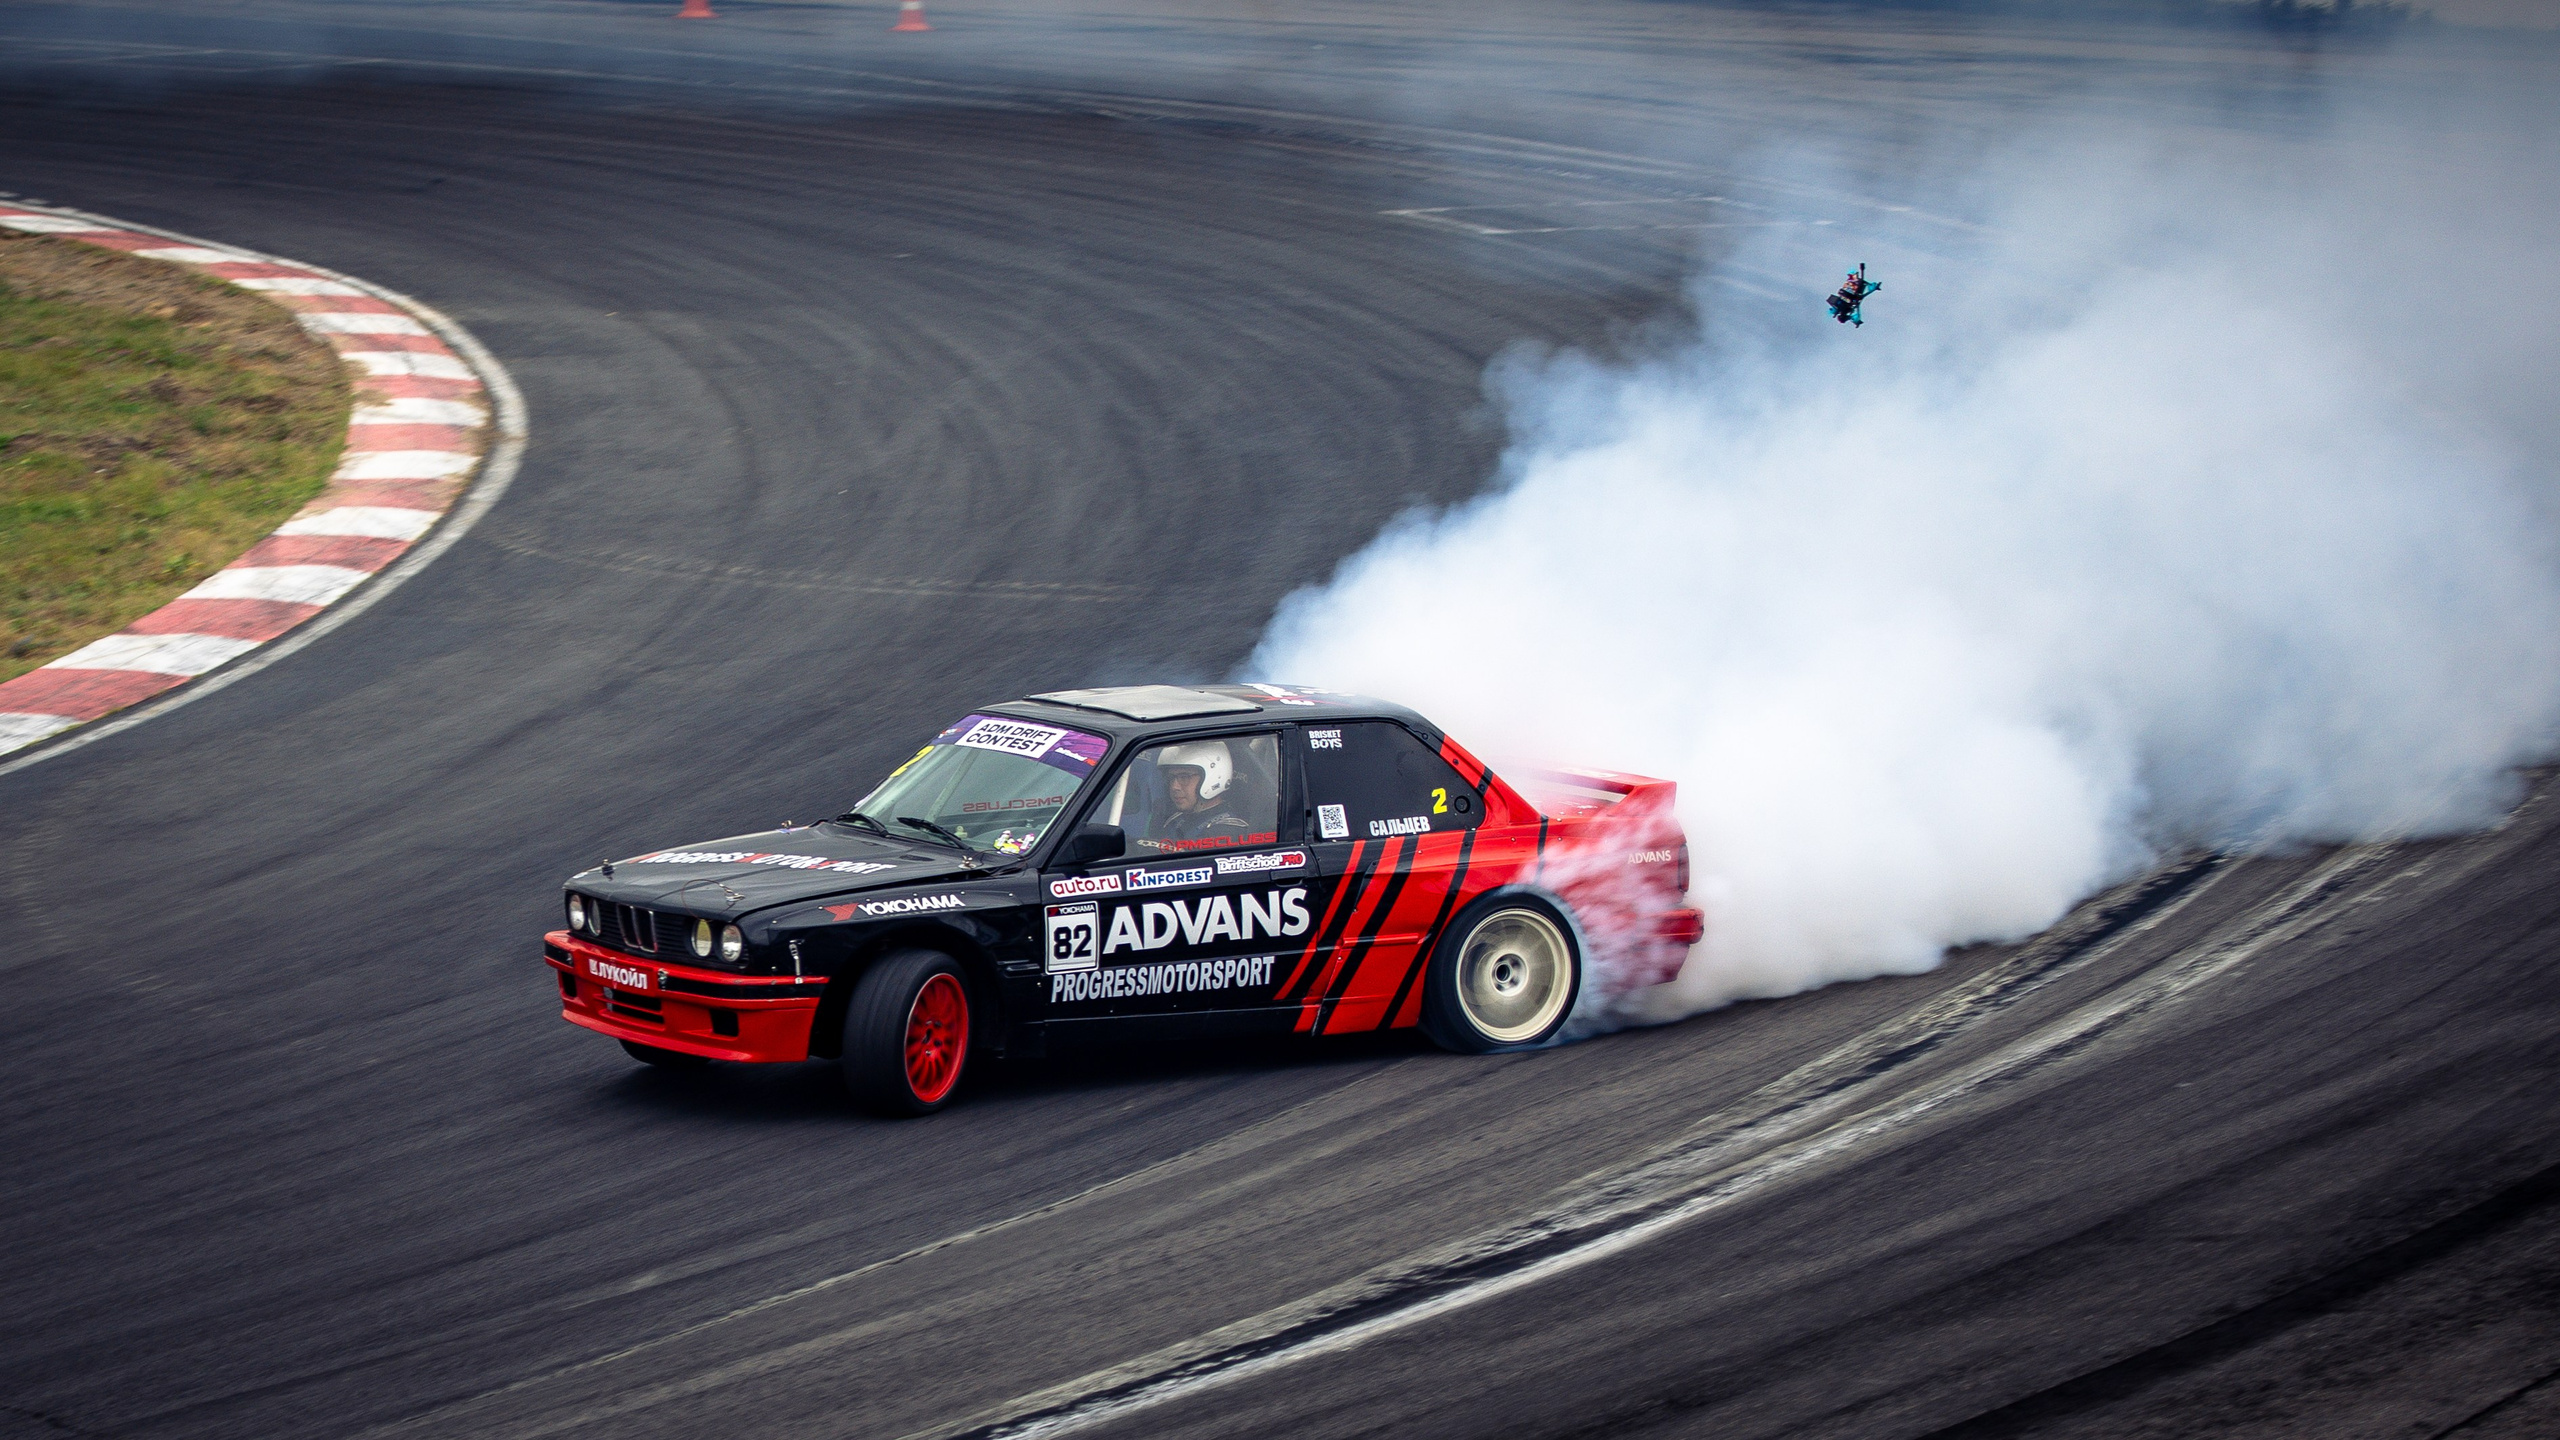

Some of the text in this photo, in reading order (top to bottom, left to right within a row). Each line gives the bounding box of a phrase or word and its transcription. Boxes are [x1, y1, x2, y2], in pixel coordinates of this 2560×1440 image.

[966, 732, 1046, 752] CONTEST
[978, 723, 1013, 735] ADM
[1011, 726, 1057, 741] DRIFT
[1308, 729, 1341, 739] BRISKET
[1310, 738, 1342, 750] BOYS
[1431, 787, 1448, 814] 2
[1369, 816, 1431, 837] САЛЬЦЕВ
[1176, 831, 1277, 851] PMSCLUBS
[1628, 850, 1671, 864] ADVANS
[1053, 875, 1119, 896] auto.ru
[1129, 869, 1210, 889] KINFOREST
[858, 894, 966, 916] YOKOHAMA
[1058, 904, 1095, 915] YOKOHAMA
[1102, 888, 1310, 955] ADVANS
[1053, 923, 1092, 960] 82
[599, 961, 648, 990] ЛУКОЙЛ
[1051, 956, 1275, 1003] PROGRESSMOTORSPORT
